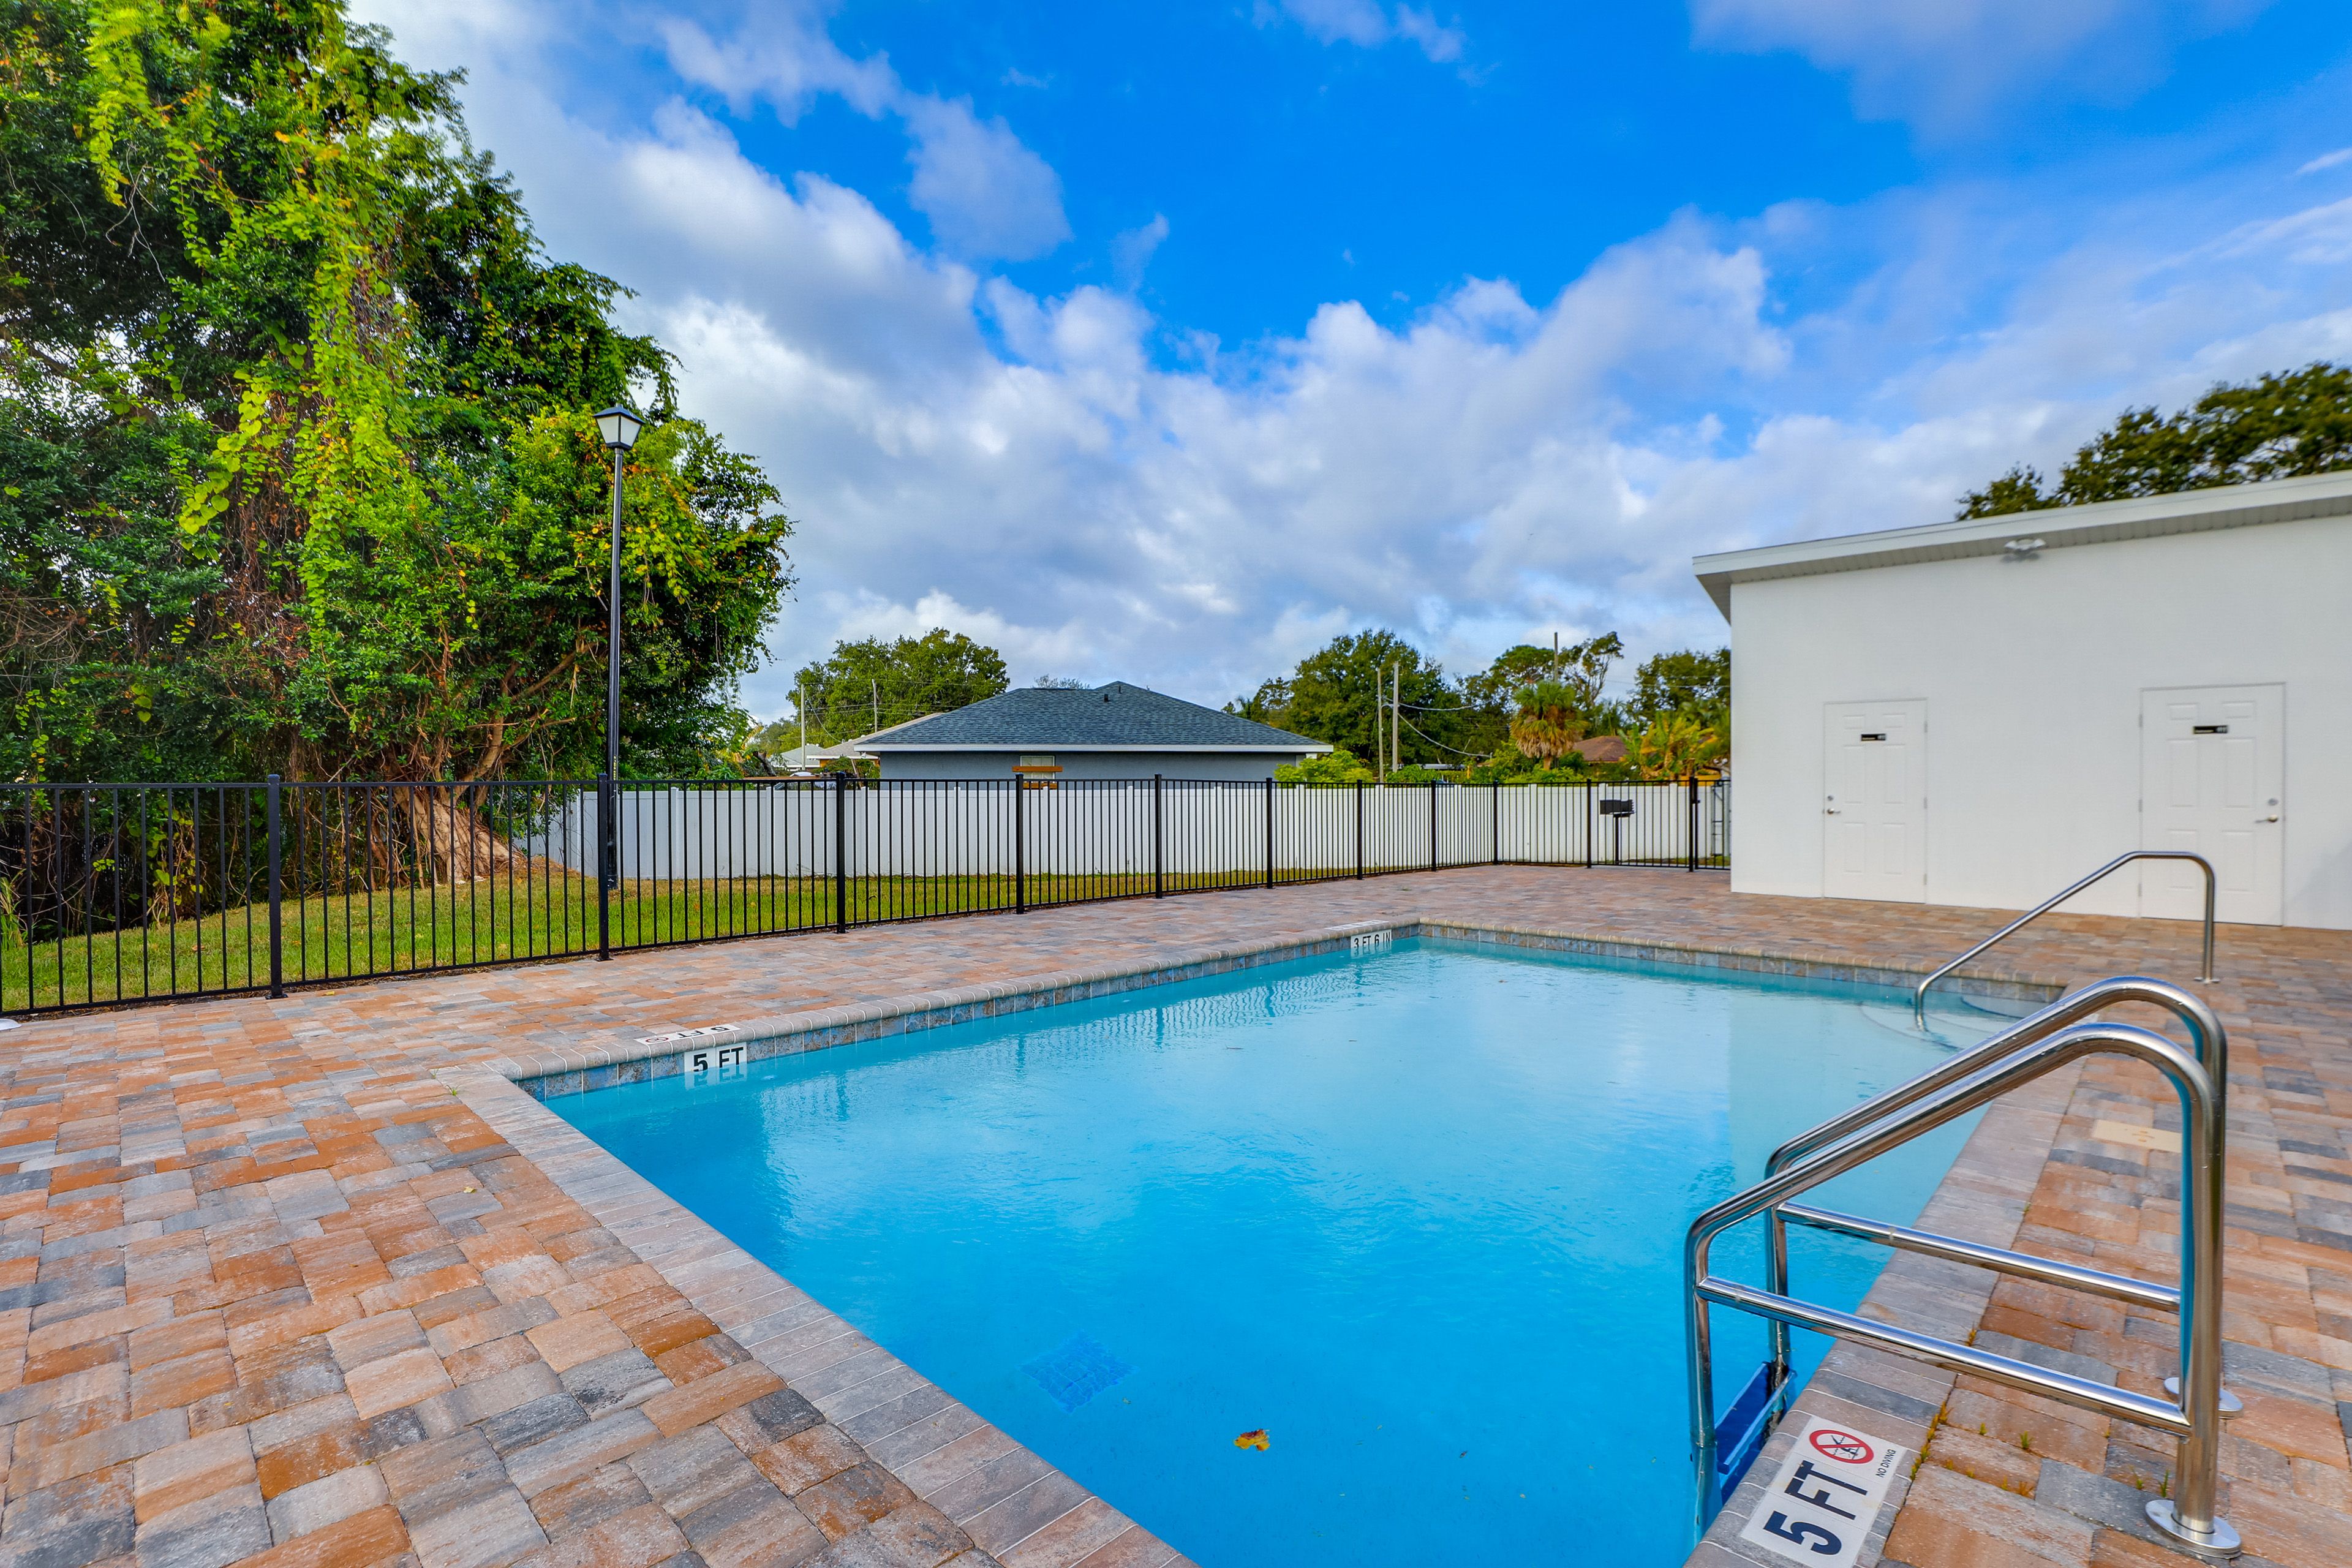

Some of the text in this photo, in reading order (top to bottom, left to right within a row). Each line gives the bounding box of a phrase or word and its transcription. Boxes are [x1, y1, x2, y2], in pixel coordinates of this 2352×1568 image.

[1354, 932, 1390, 948] 3 FT 6 IN
[677, 1030, 705, 1039] FT
[693, 1047, 744, 1072] 5 FT
[1875, 1449, 1896, 1478] NO DIVING
[1763, 1460, 1868, 1555] 5 FT
